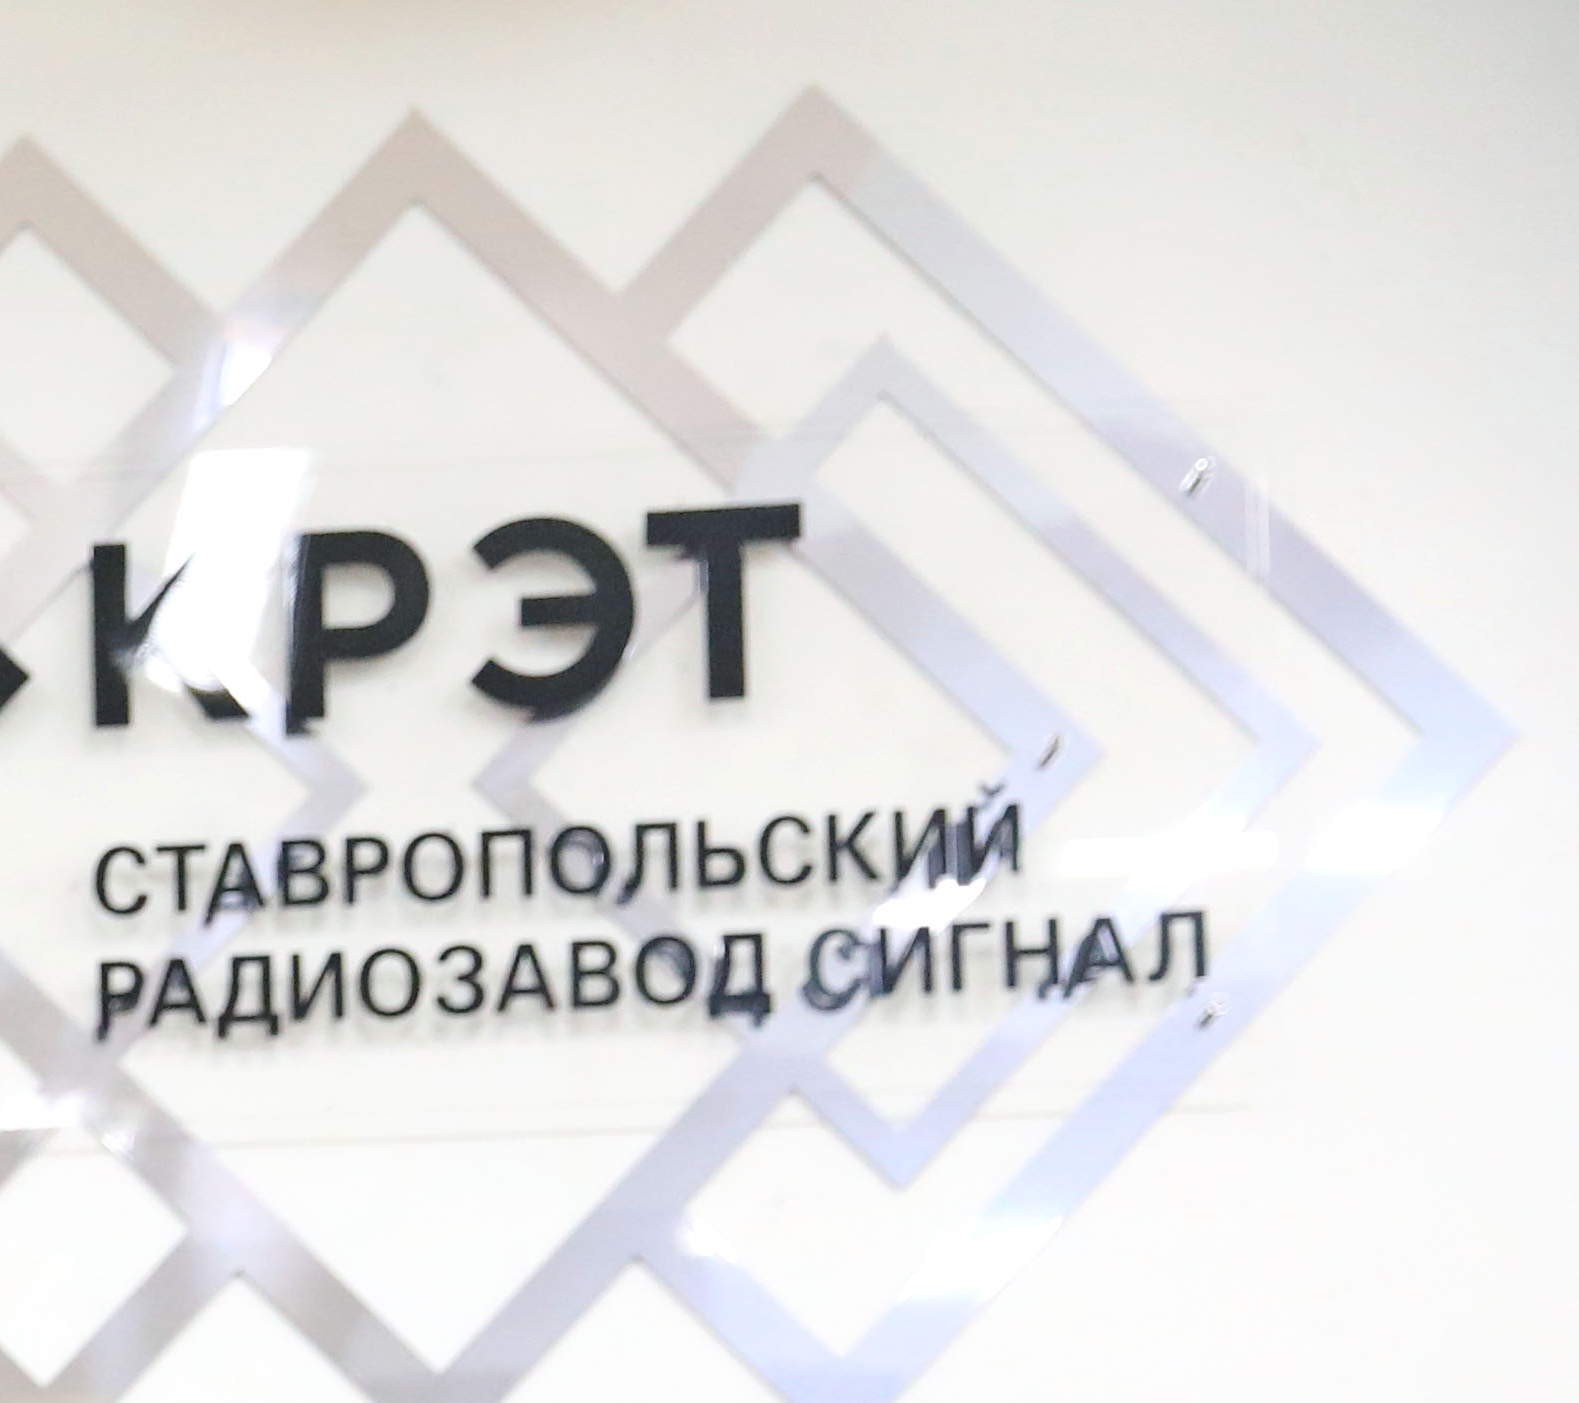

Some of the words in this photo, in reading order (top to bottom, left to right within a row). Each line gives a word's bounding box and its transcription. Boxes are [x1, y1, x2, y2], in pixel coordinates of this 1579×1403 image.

[90, 502, 804, 733] КРЭТ
[93, 783, 1026, 924] СТАВРОПОЛЬСКИЙ
[93, 930, 775, 1044] РАДИОЗАВОД
[806, 909, 1213, 1012] СИГНАЛ
